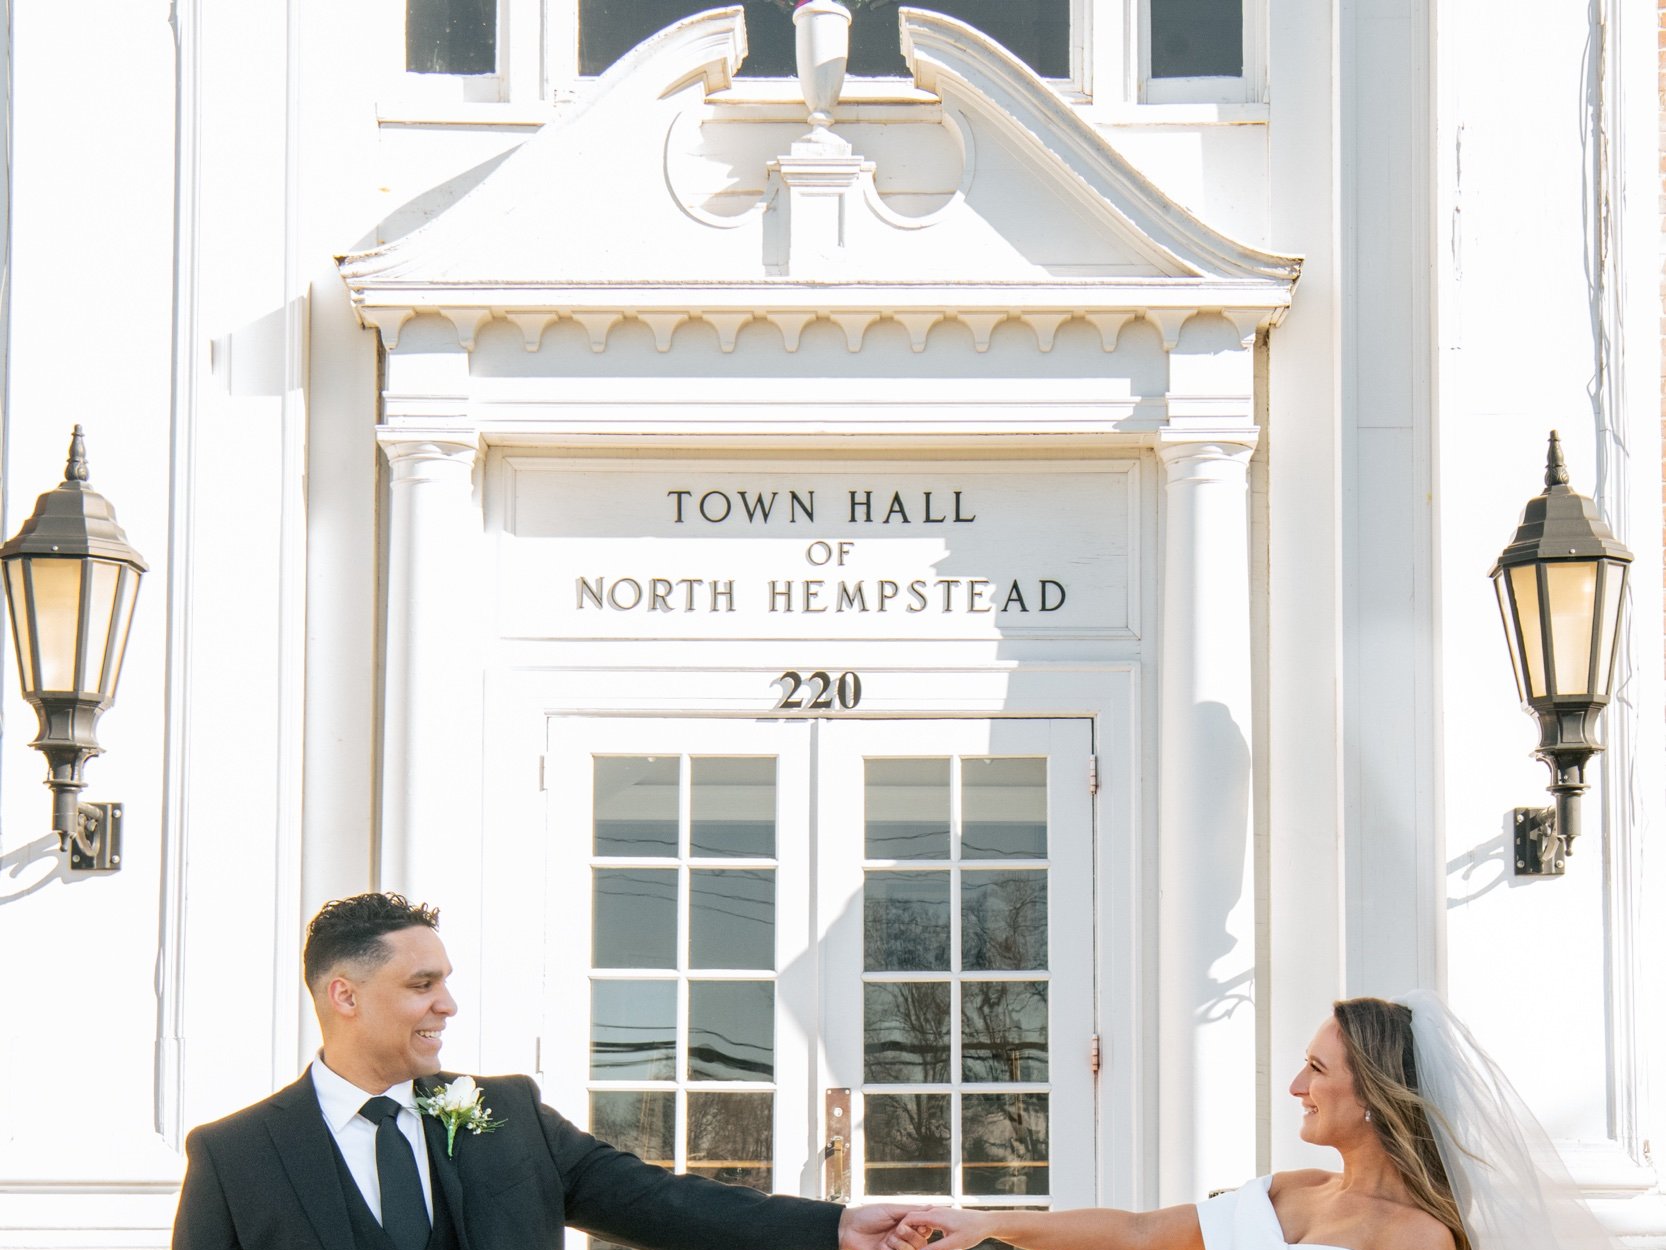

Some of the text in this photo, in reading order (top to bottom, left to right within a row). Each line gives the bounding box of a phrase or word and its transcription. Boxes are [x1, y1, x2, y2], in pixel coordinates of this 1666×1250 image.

[667, 490, 976, 523] TOWN HALL
[806, 541, 855, 566] OF
[576, 576, 1066, 613] NORTH HEMPSTEAD
[778, 671, 862, 710] 220
